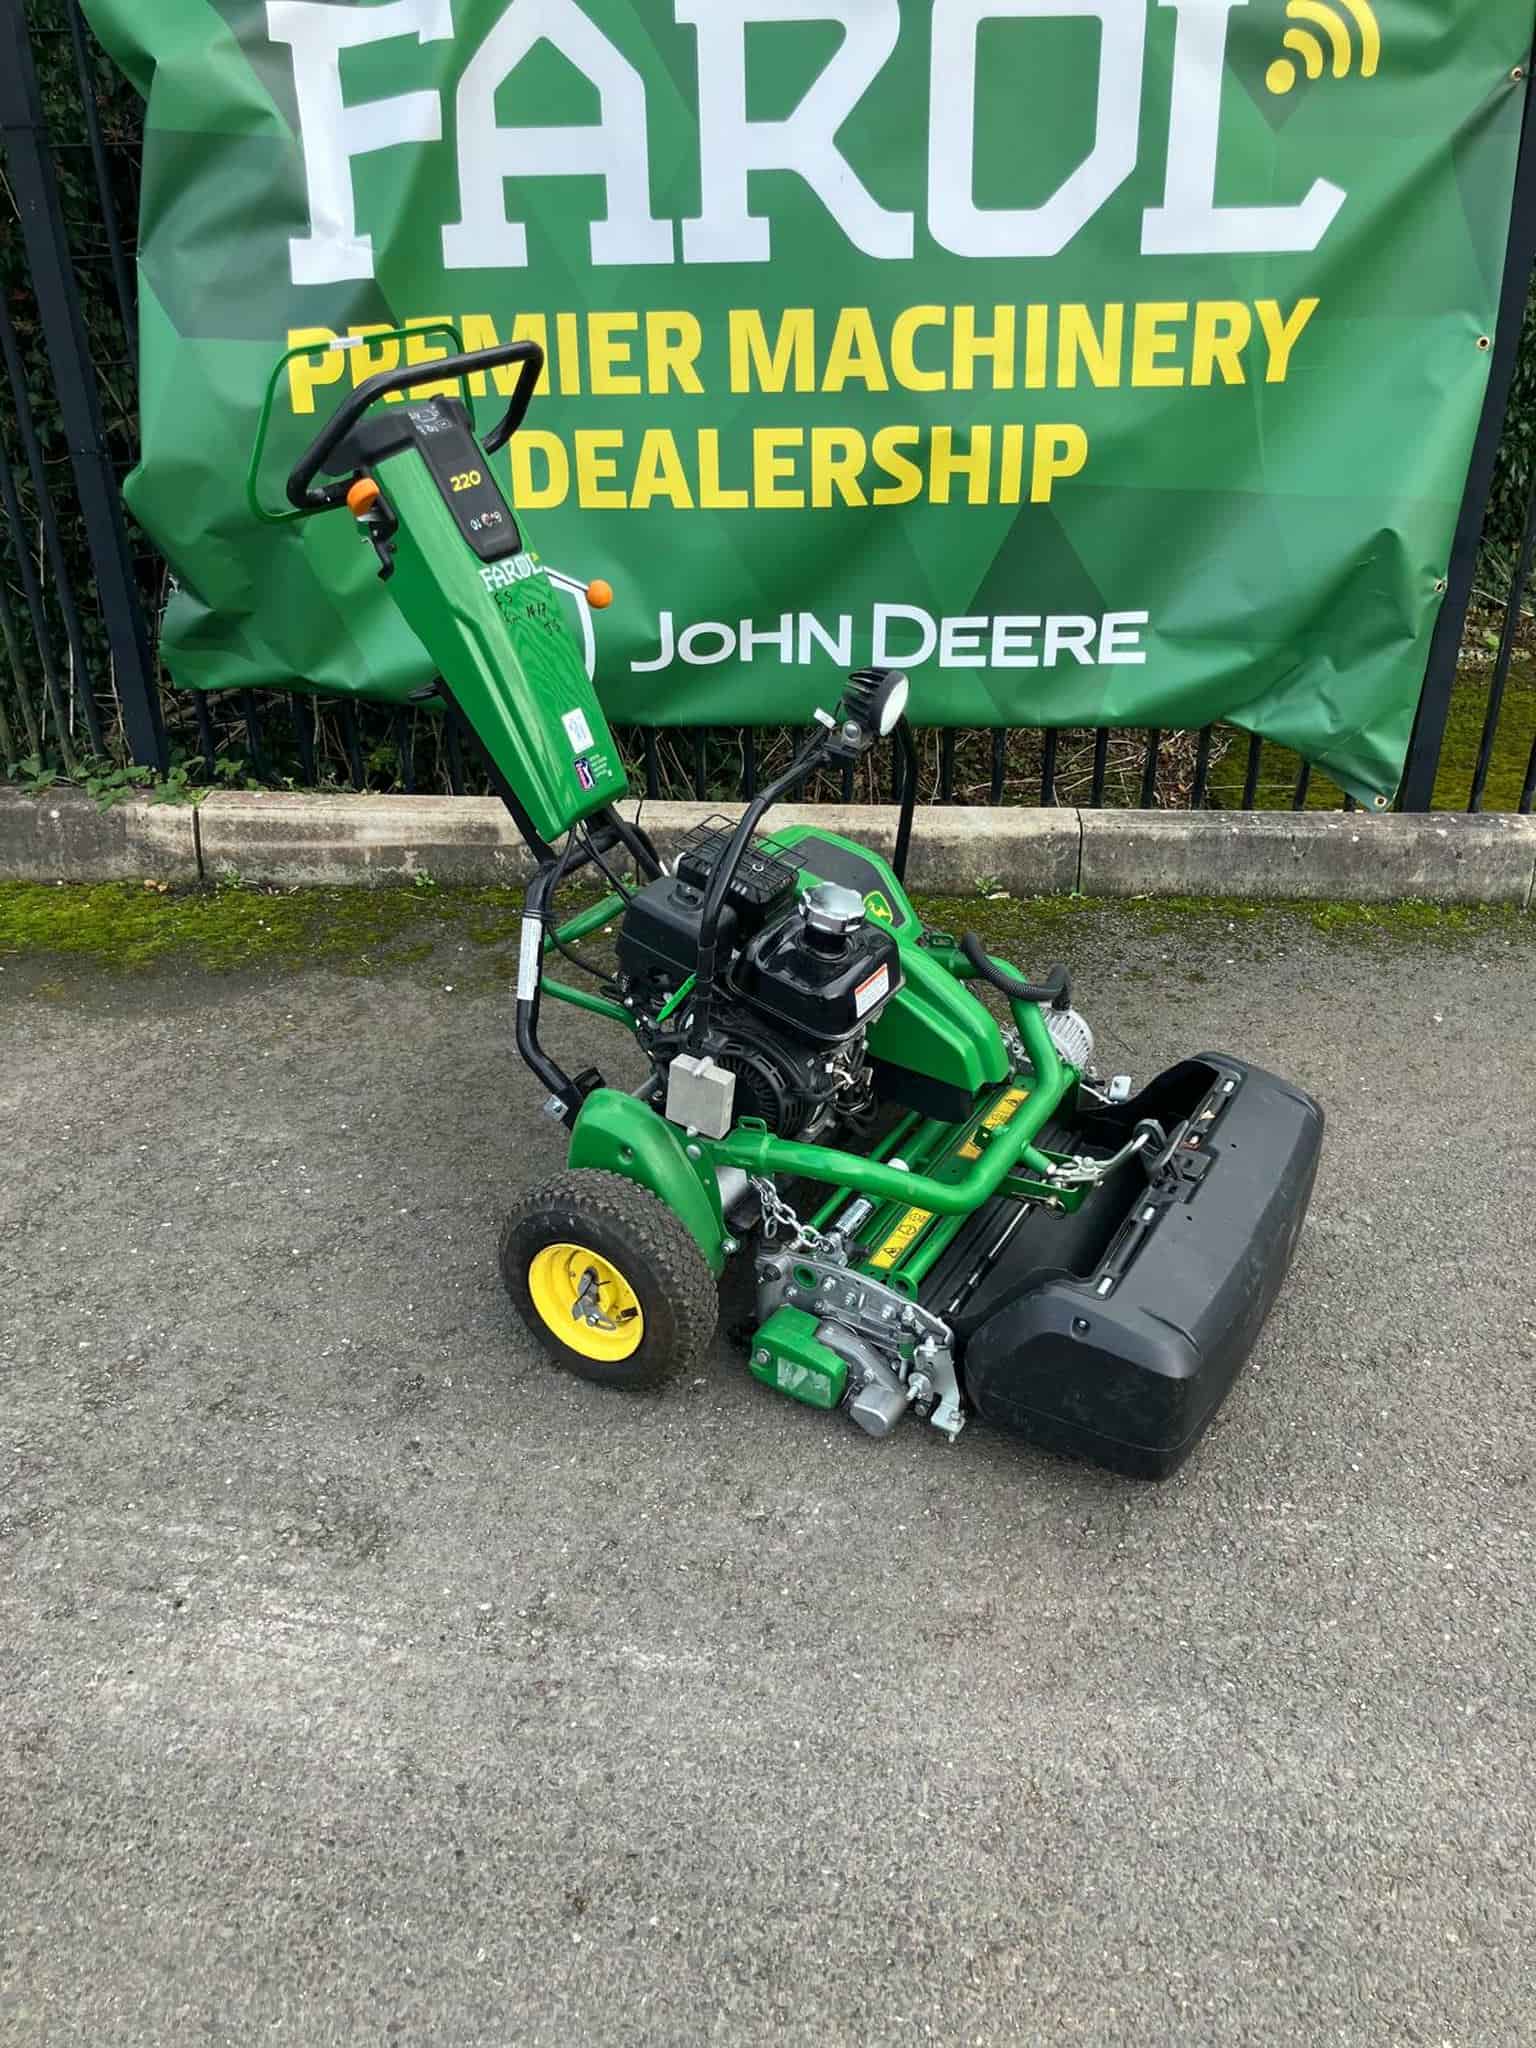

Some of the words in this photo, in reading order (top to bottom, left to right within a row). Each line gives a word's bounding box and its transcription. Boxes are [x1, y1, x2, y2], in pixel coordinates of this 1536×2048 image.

[264, 0, 1347, 285] FAROL
[287, 309, 703, 414] PREMIER
[728, 297, 1321, 394] MACHINERY
[450, 468, 482, 493] 220
[508, 423, 1089, 510] DEALERSHIP
[478, 552, 544, 592] FAROL
[630, 610, 853, 672] JOHN
[871, 602, 1150, 669] DEERE
